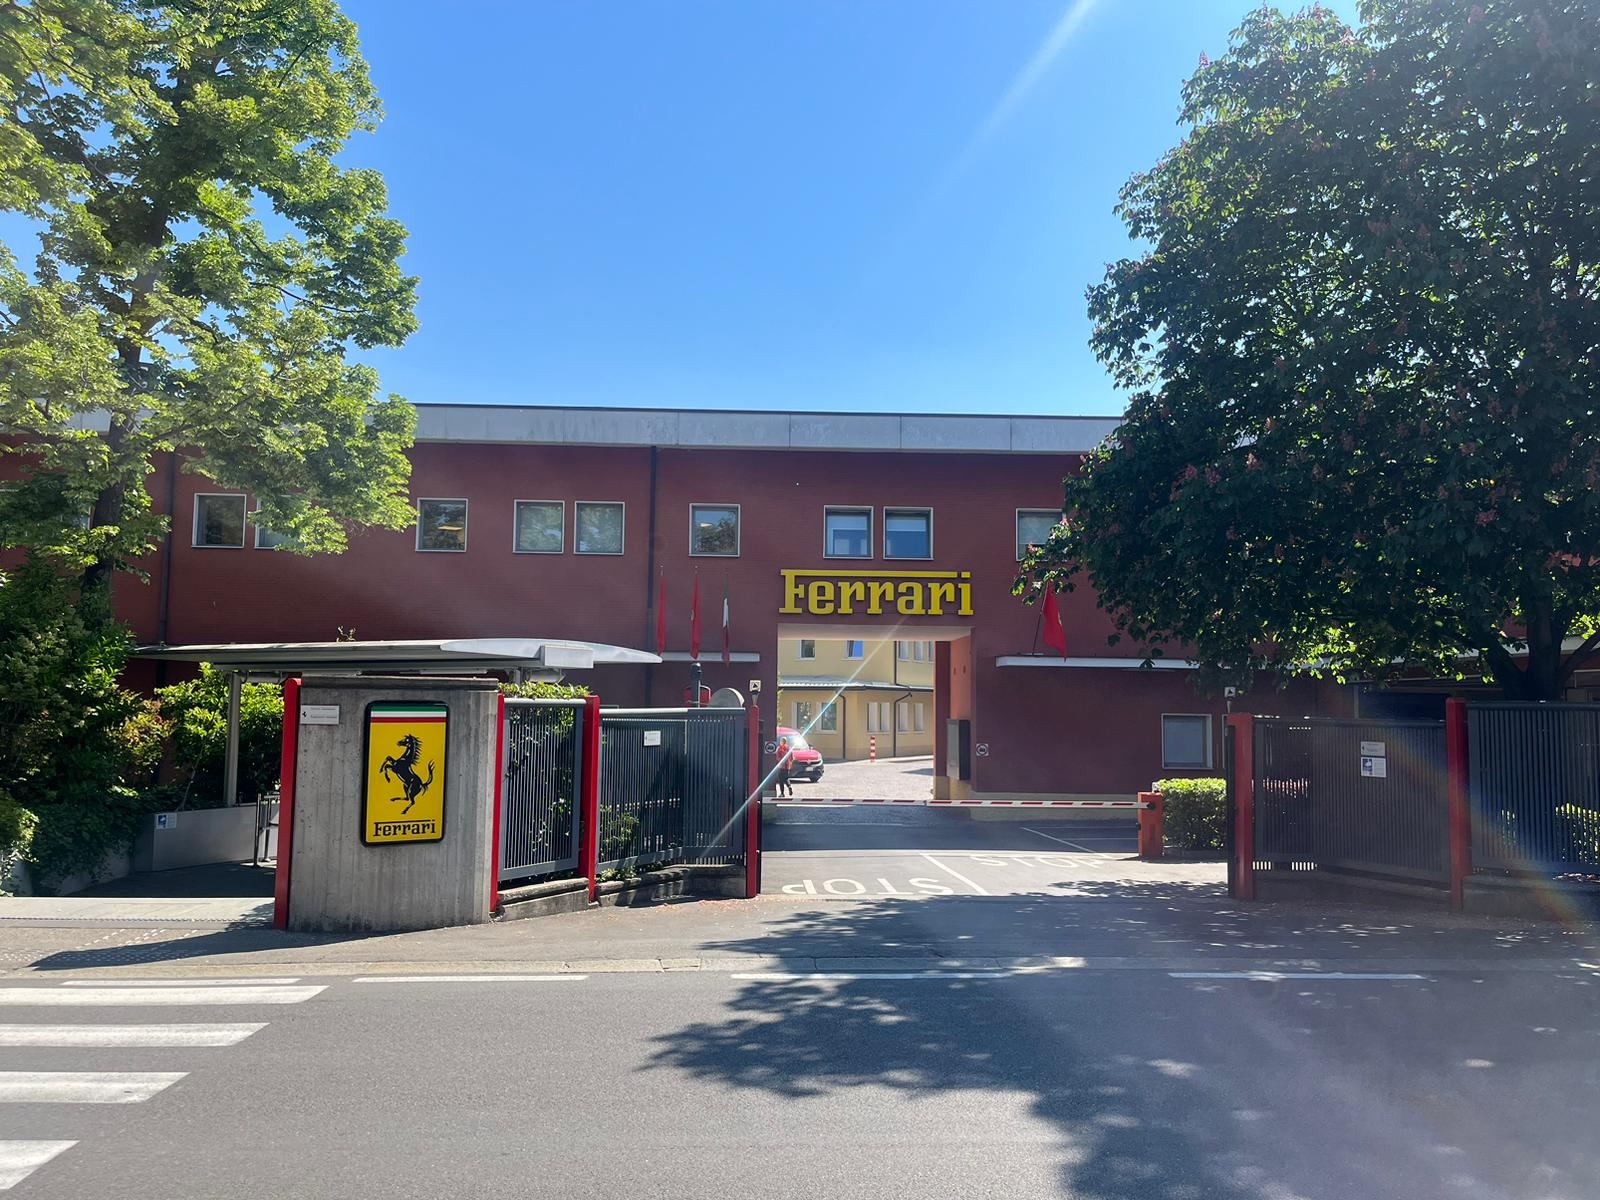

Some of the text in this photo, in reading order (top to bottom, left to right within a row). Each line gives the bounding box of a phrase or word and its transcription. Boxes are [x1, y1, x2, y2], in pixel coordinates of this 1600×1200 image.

[778, 569, 974, 616] Ferrari
[372, 819, 436, 837] Ferrari
[970, 855, 1104, 869] STOP
[781, 877, 954, 896] STOP
